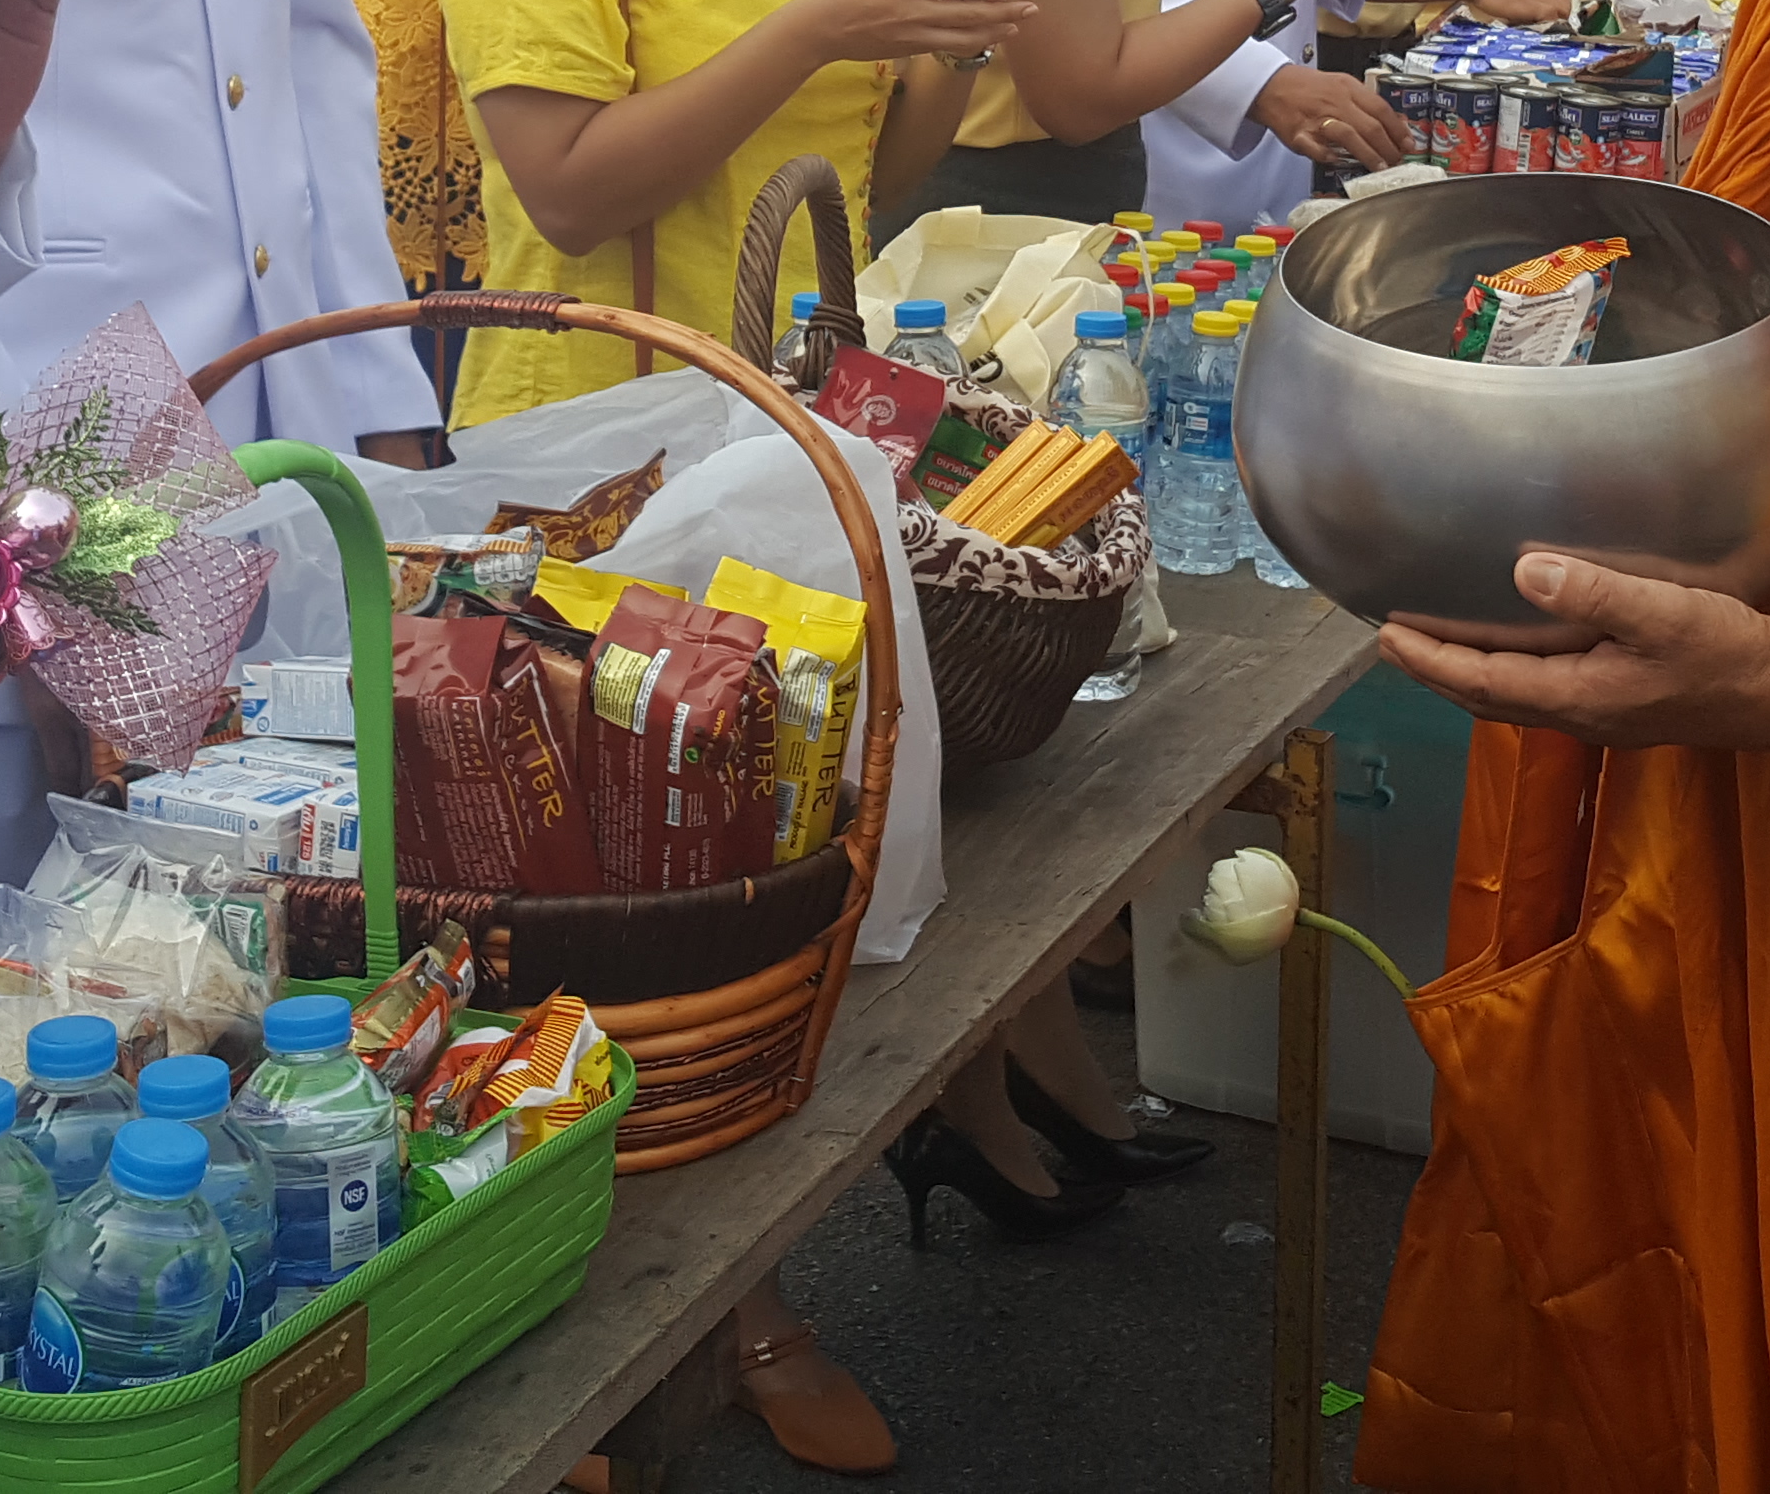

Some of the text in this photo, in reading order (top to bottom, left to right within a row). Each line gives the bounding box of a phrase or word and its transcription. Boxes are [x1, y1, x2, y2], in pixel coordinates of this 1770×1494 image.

[1623, 110, 1657, 123] EALECT
[510, 676, 564, 829] BUTTER
[811, 673, 857, 813] BUTTER
[343, 1186, 367, 1206] NSF
